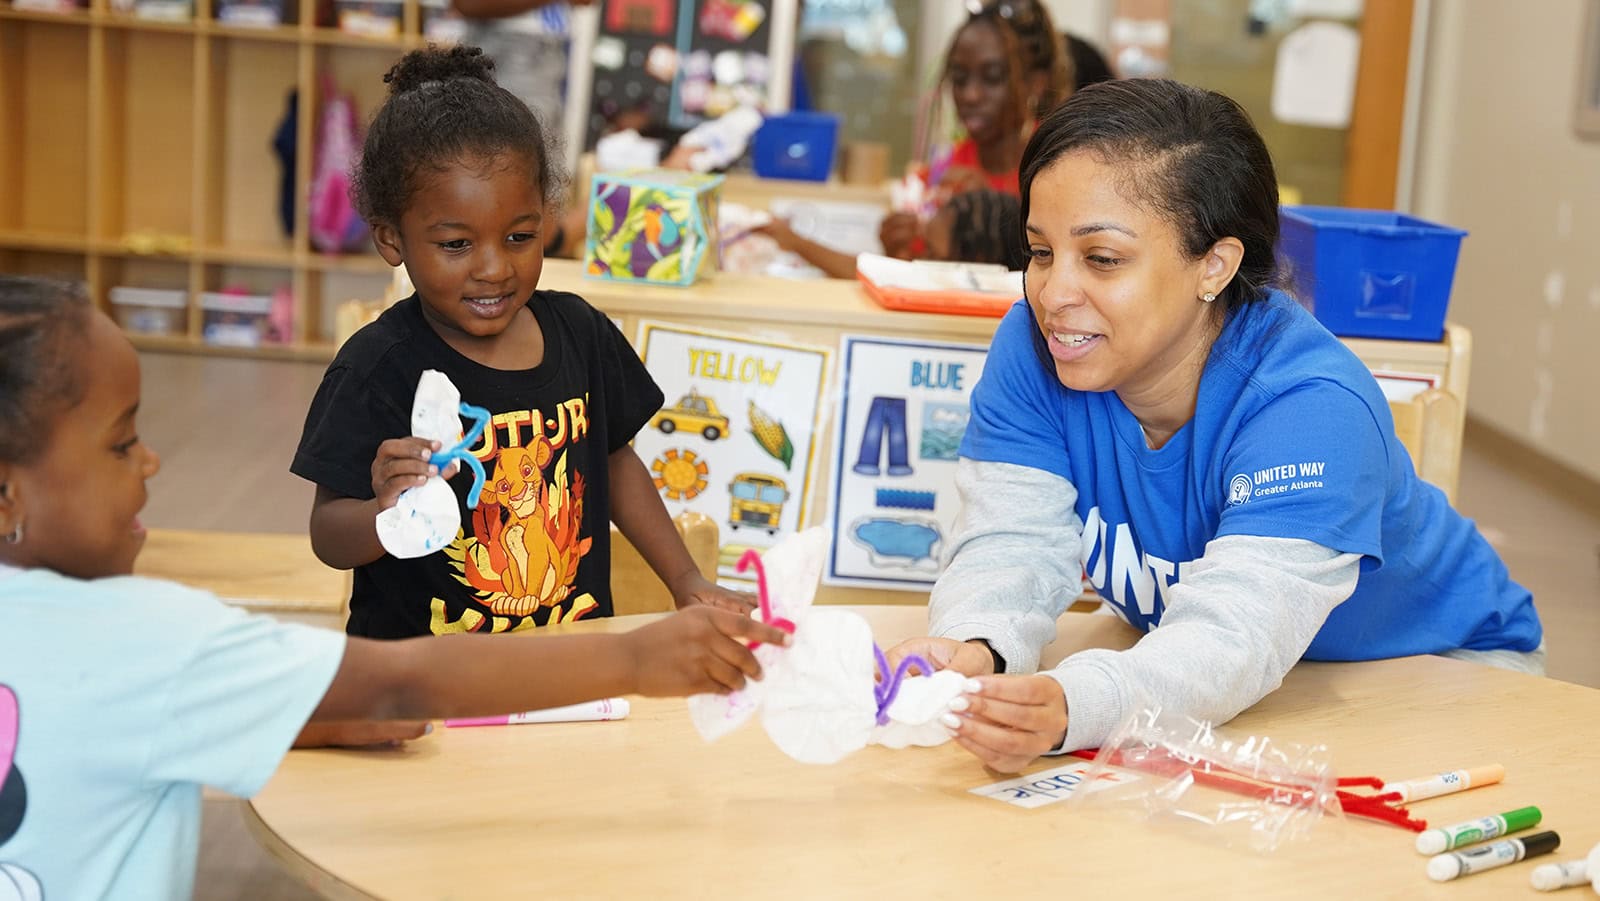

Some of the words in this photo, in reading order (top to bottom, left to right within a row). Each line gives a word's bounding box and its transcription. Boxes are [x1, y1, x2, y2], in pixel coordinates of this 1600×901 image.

[688, 347, 782, 387] YELLOW
[910, 360, 965, 391] BLUE
[1253, 464, 1297, 485] UNITED
[1299, 462, 1326, 477] WAY
[1254, 484, 1289, 497] Greater
[1290, 480, 1323, 491] Atlanta
